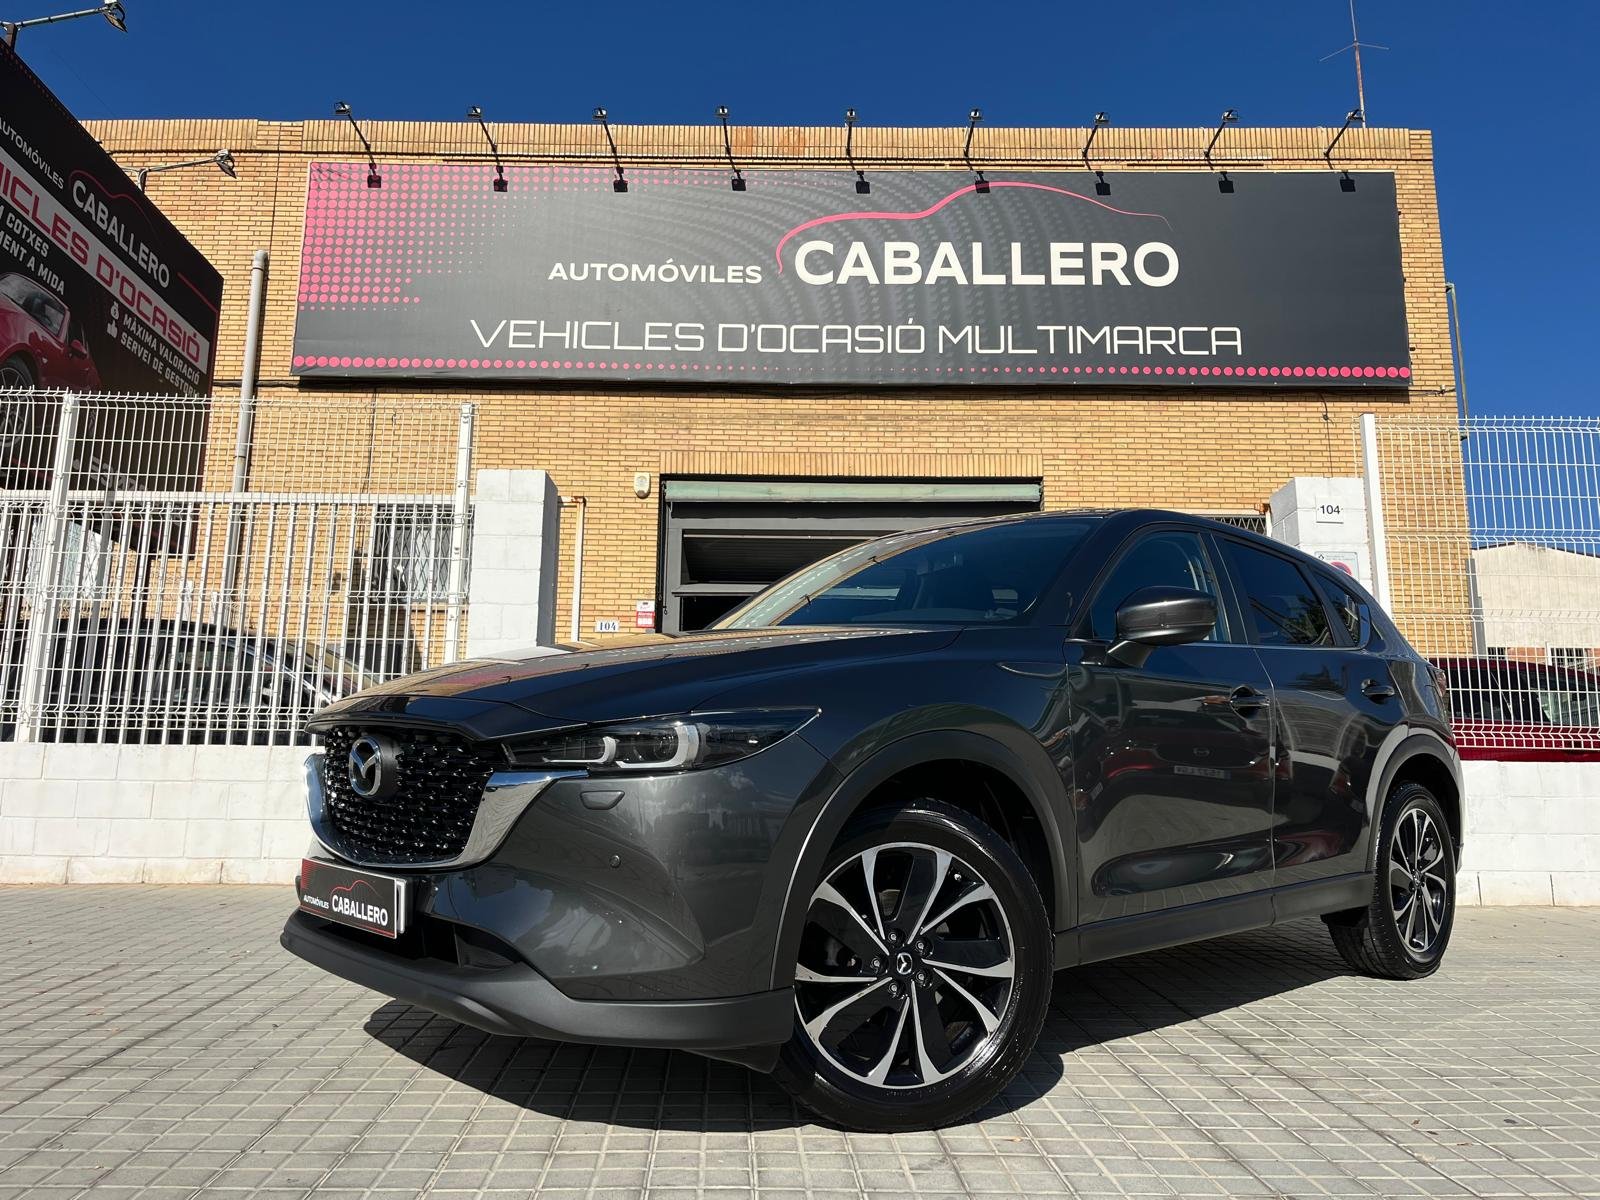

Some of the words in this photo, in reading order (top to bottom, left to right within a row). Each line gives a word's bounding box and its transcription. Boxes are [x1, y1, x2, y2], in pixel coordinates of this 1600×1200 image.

[6, 212, 49, 258] COTXES
[72, 179, 170, 288] CABALLERO
[0, 161, 90, 266] ICLES
[96, 260, 201, 364] D'OCASIÓ
[0, 230, 27, 262] ENT
[26, 252, 37, 273] A
[38, 264, 66, 296] MIDA
[548, 258, 762, 284] AUTOMÓVILES
[794, 240, 1180, 288] CABALLERO
[120, 332, 152, 364] SERVEI
[152, 356, 166, 374] DE
[470, 319, 704, 353] VEHICLES
[717, 317, 925, 355] D'OCASIÓ
[938, 325, 1242, 356] MULTIMARCA
[159, 342, 200, 385] VALORACIÓ
[1320, 504, 1340, 514] 104
[599, 622, 616, 631] 104
[303, 894, 329, 909] AUTOMÓVILES
[331, 894, 388, 926] CABALLERO
